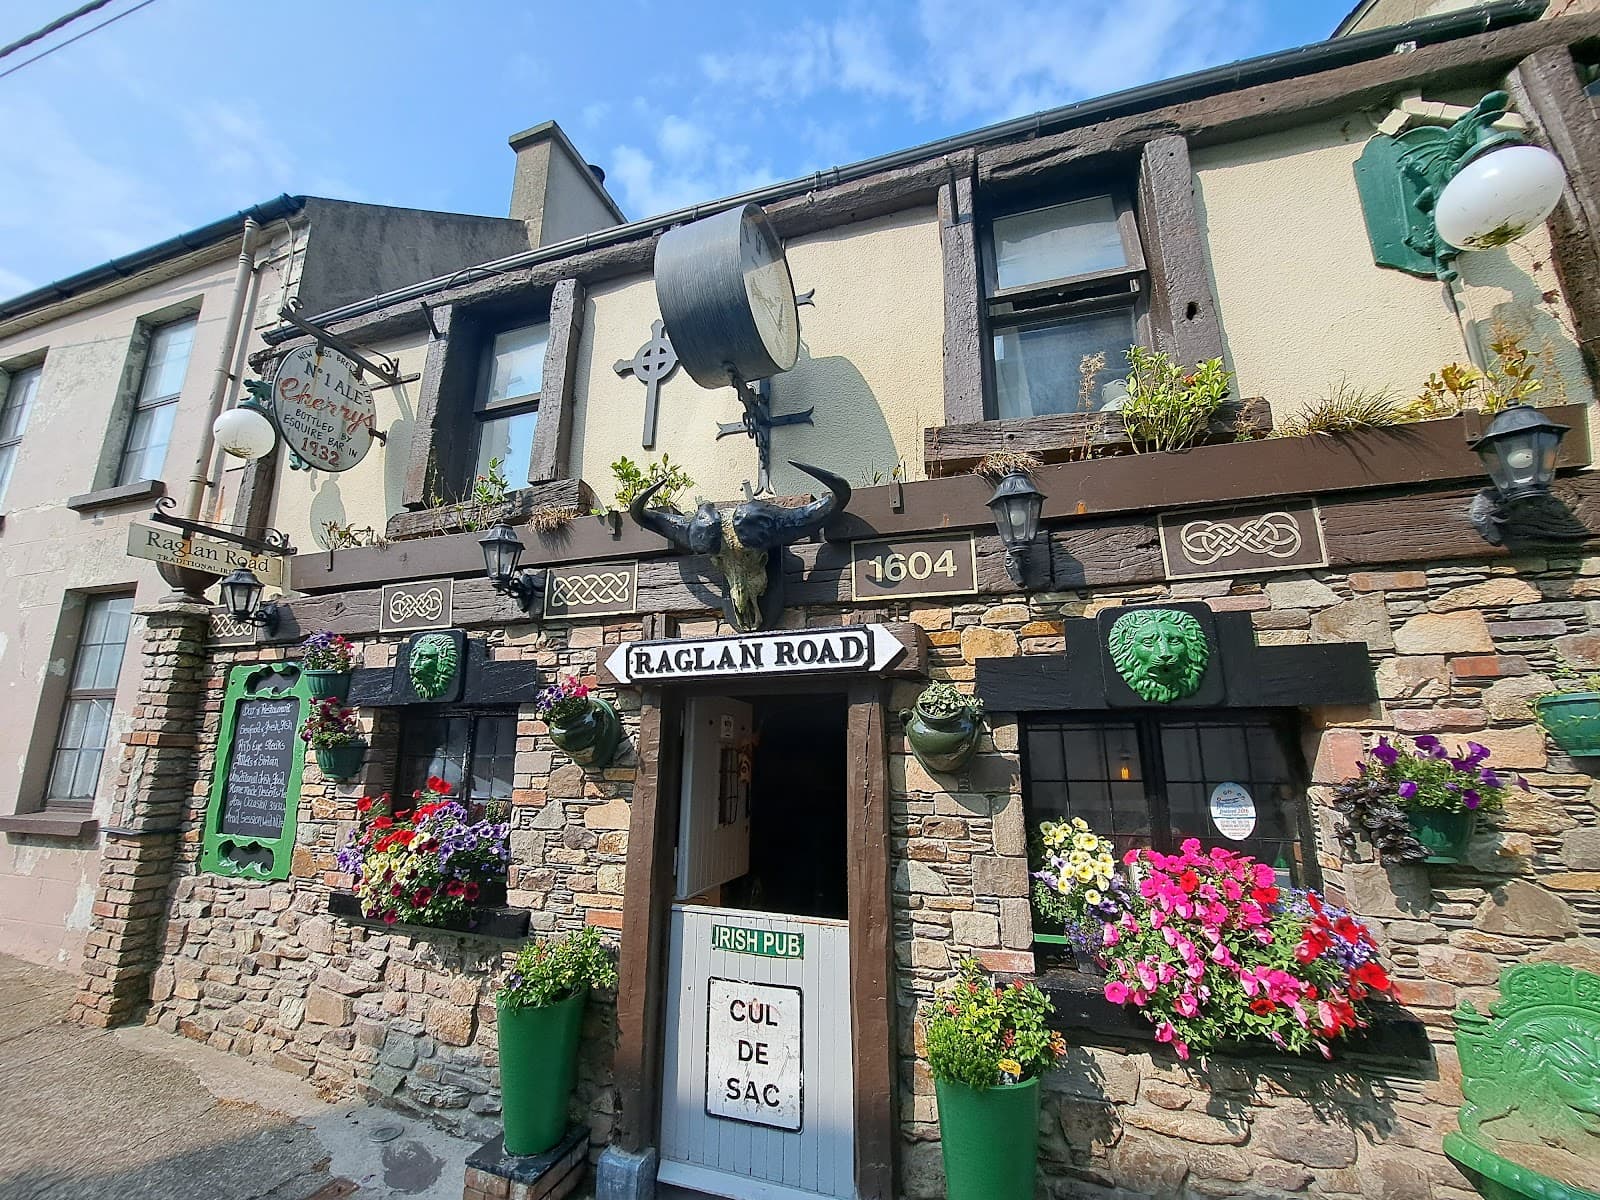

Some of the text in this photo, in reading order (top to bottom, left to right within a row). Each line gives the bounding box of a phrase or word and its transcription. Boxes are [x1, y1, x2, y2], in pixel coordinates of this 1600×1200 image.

[325, 373, 332, 388] 1
[334, 380, 363, 405] ALE
[283, 413, 358, 458] ESQUIRE BAR IN
[295, 408, 353, 443] BOTTLED BY
[301, 437, 340, 466] 1932
[146, 531, 270, 573] Raglan Road
[868, 549, 957, 582] 1604
[634, 635, 865, 675] RAGLAN ROAD
[252, 740, 263, 756] Eye
[714, 926, 801, 956] IRISH PUB
[729, 999, 779, 1027] CUL
[738, 1039, 769, 1066] DE
[726, 1077, 780, 1108] SAC
